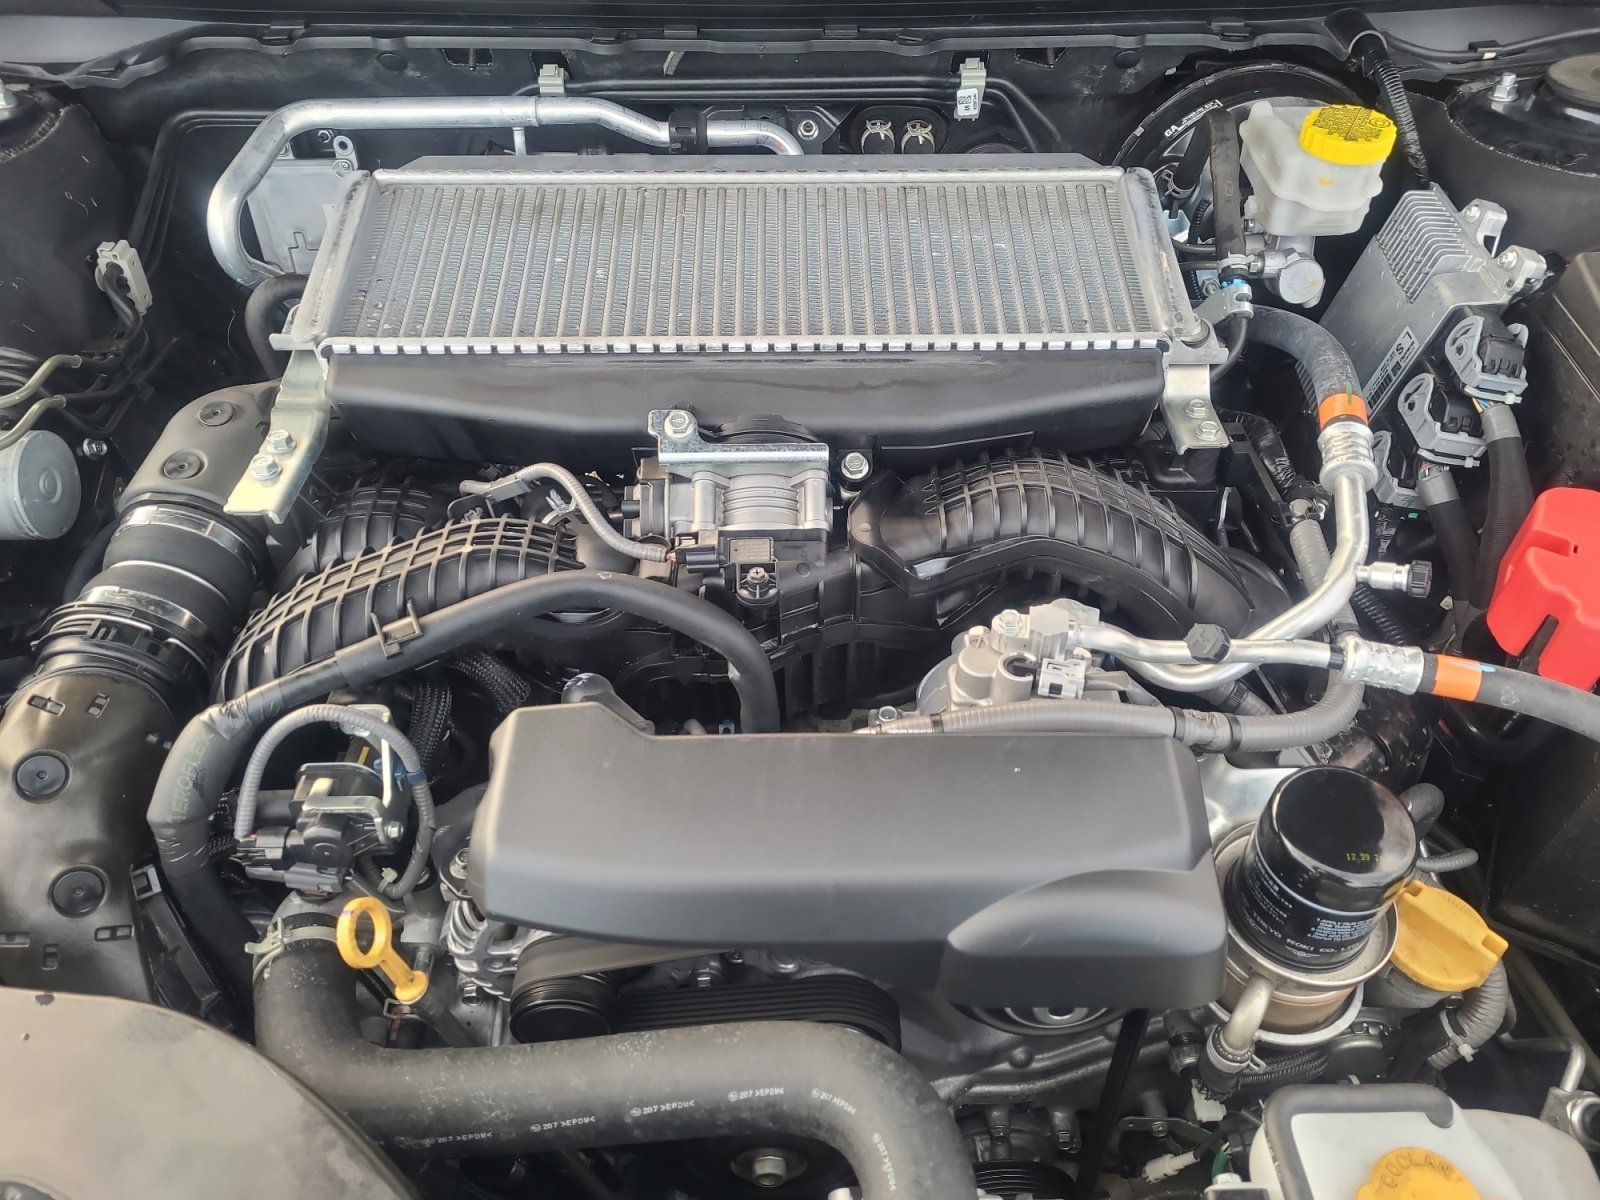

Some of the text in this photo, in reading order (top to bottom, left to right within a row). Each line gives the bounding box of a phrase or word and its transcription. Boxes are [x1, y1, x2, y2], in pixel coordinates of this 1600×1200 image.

[1252, 909, 1282, 938] TOKYO
[1286, 938, 1315, 952] ROKI
[739, 1090, 753, 1100] 207
[642, 1105, 658, 1114] 207
[542, 1121, 558, 1130] 207
[437, 1135, 453, 1143] 207
[1380, 1151, 1463, 1188] COOLAN
